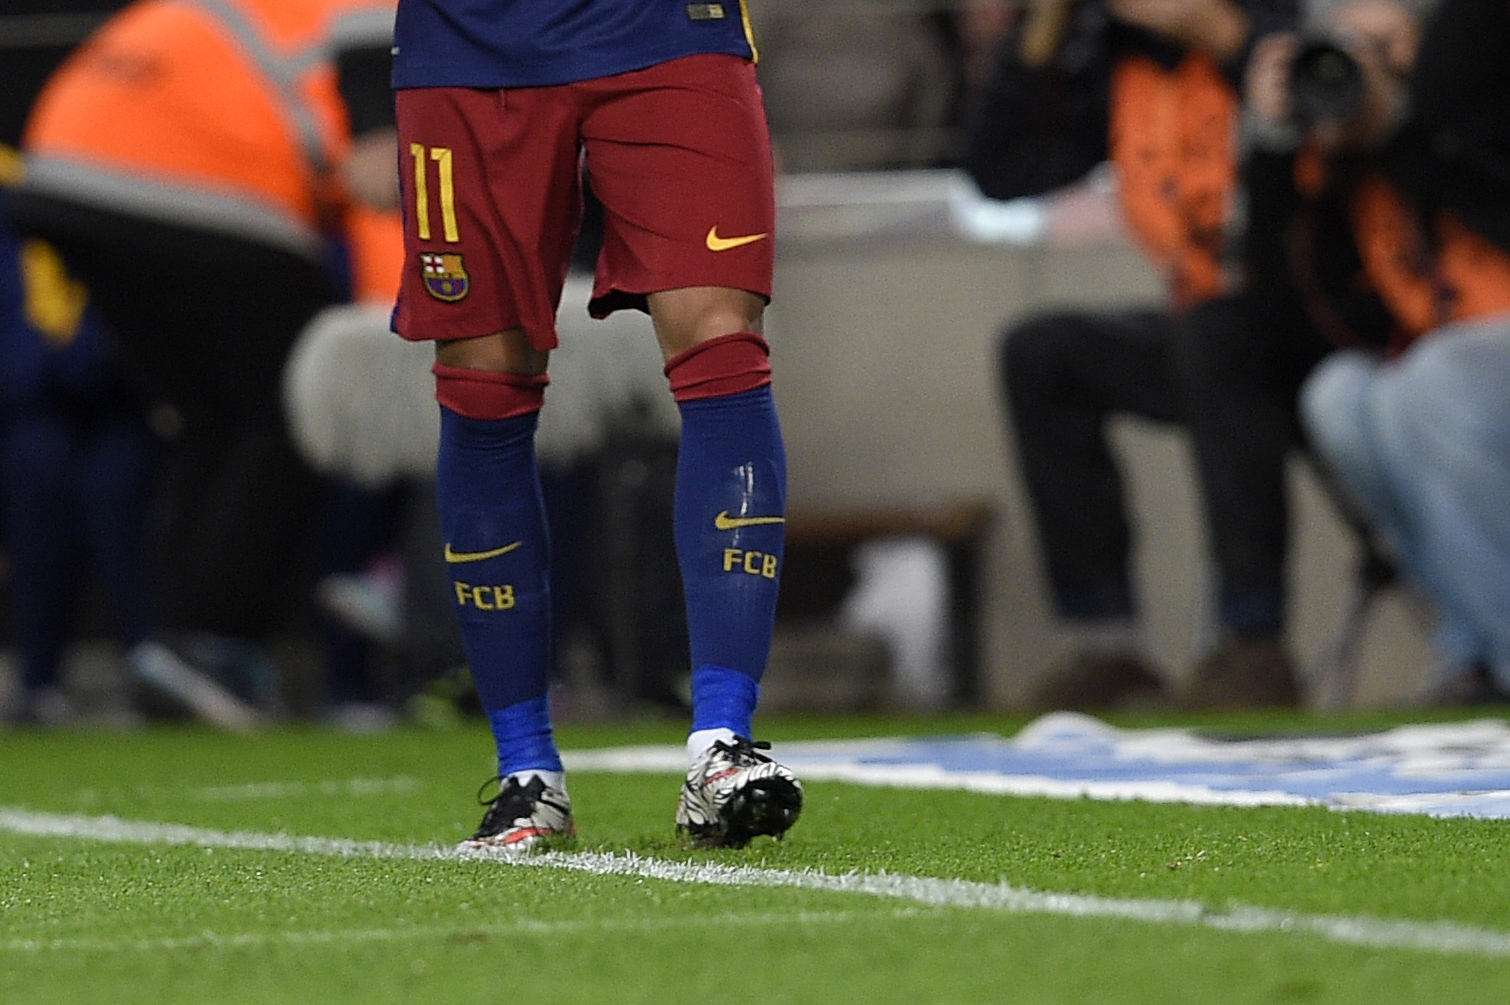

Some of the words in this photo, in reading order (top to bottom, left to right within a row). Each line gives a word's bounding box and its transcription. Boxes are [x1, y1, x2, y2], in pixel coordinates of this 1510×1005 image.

[409, 142, 461, 244] 11
[722, 547, 779, 580] FCB
[453, 580, 516, 612] FCB
